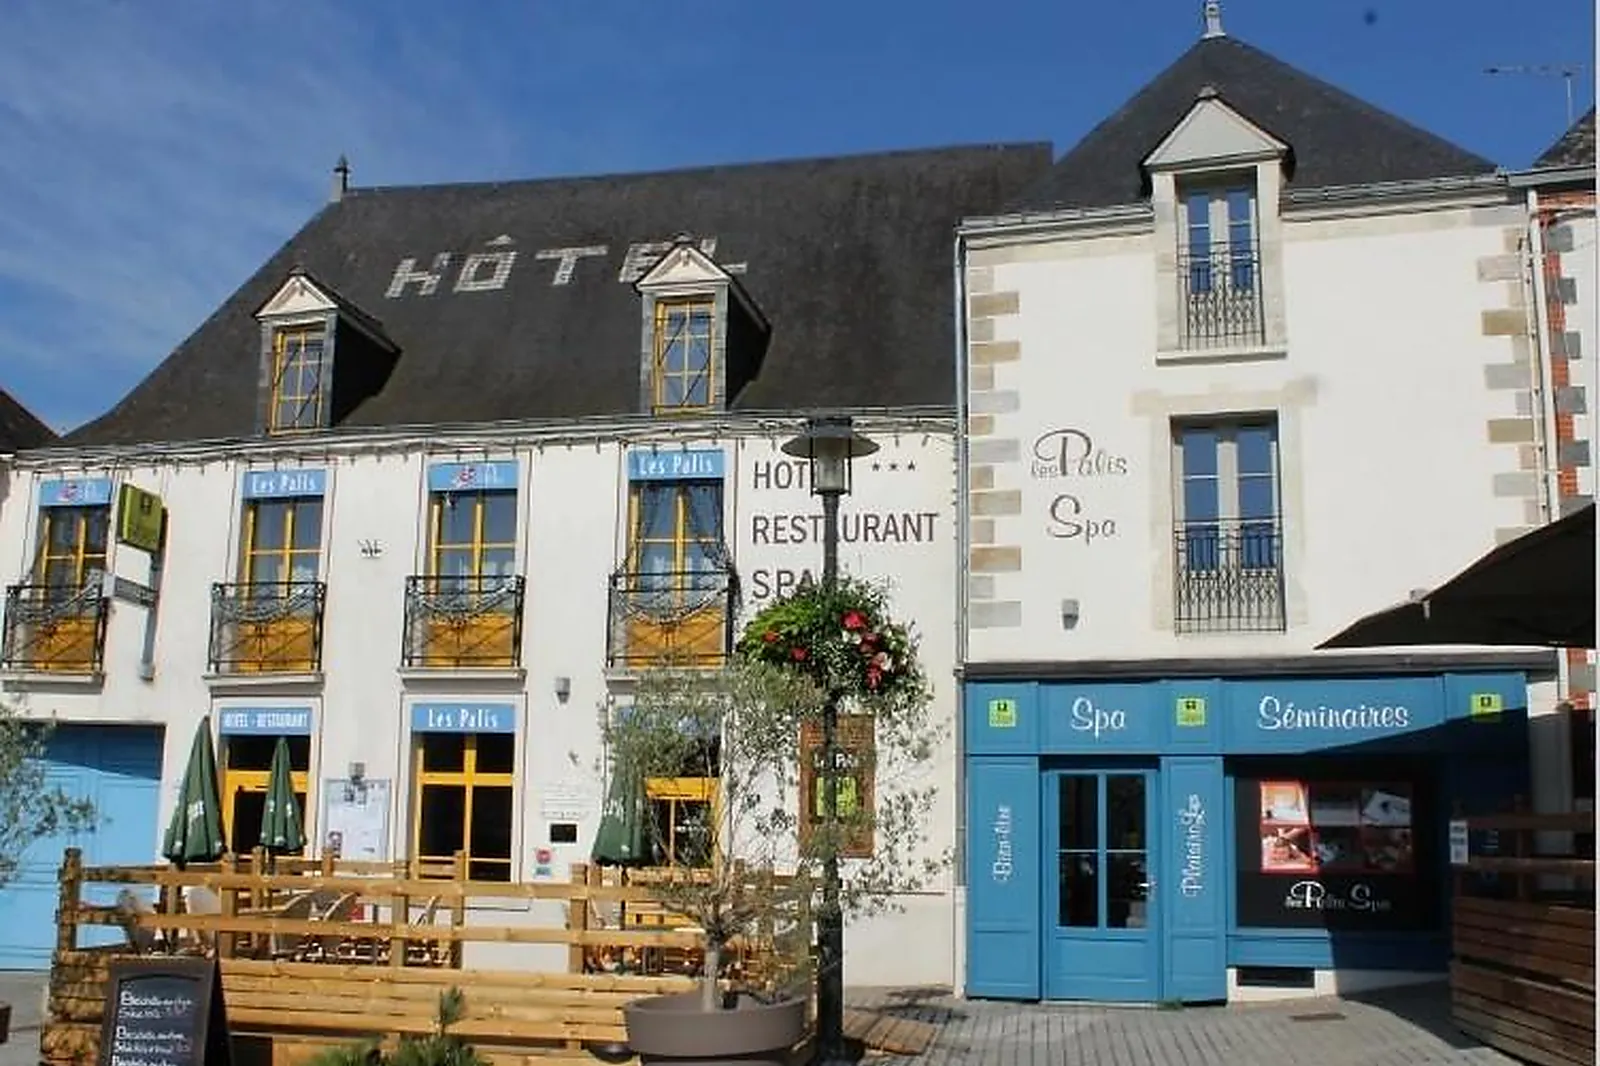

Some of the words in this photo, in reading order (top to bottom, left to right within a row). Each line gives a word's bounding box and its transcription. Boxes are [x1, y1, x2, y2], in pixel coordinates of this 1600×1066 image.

[640, 455, 665, 475] Les
[754, 461, 826, 489] HOT
[252, 474, 275, 493] Les
[753, 513, 940, 544] RESTURANT
[1046, 494, 1116, 546] Spa
[428, 708, 453, 728] Les
[460, 708, 498, 728] Palis
[1071, 697, 1125, 739] Spa
[1258, 696, 1409, 730] Séminaires
